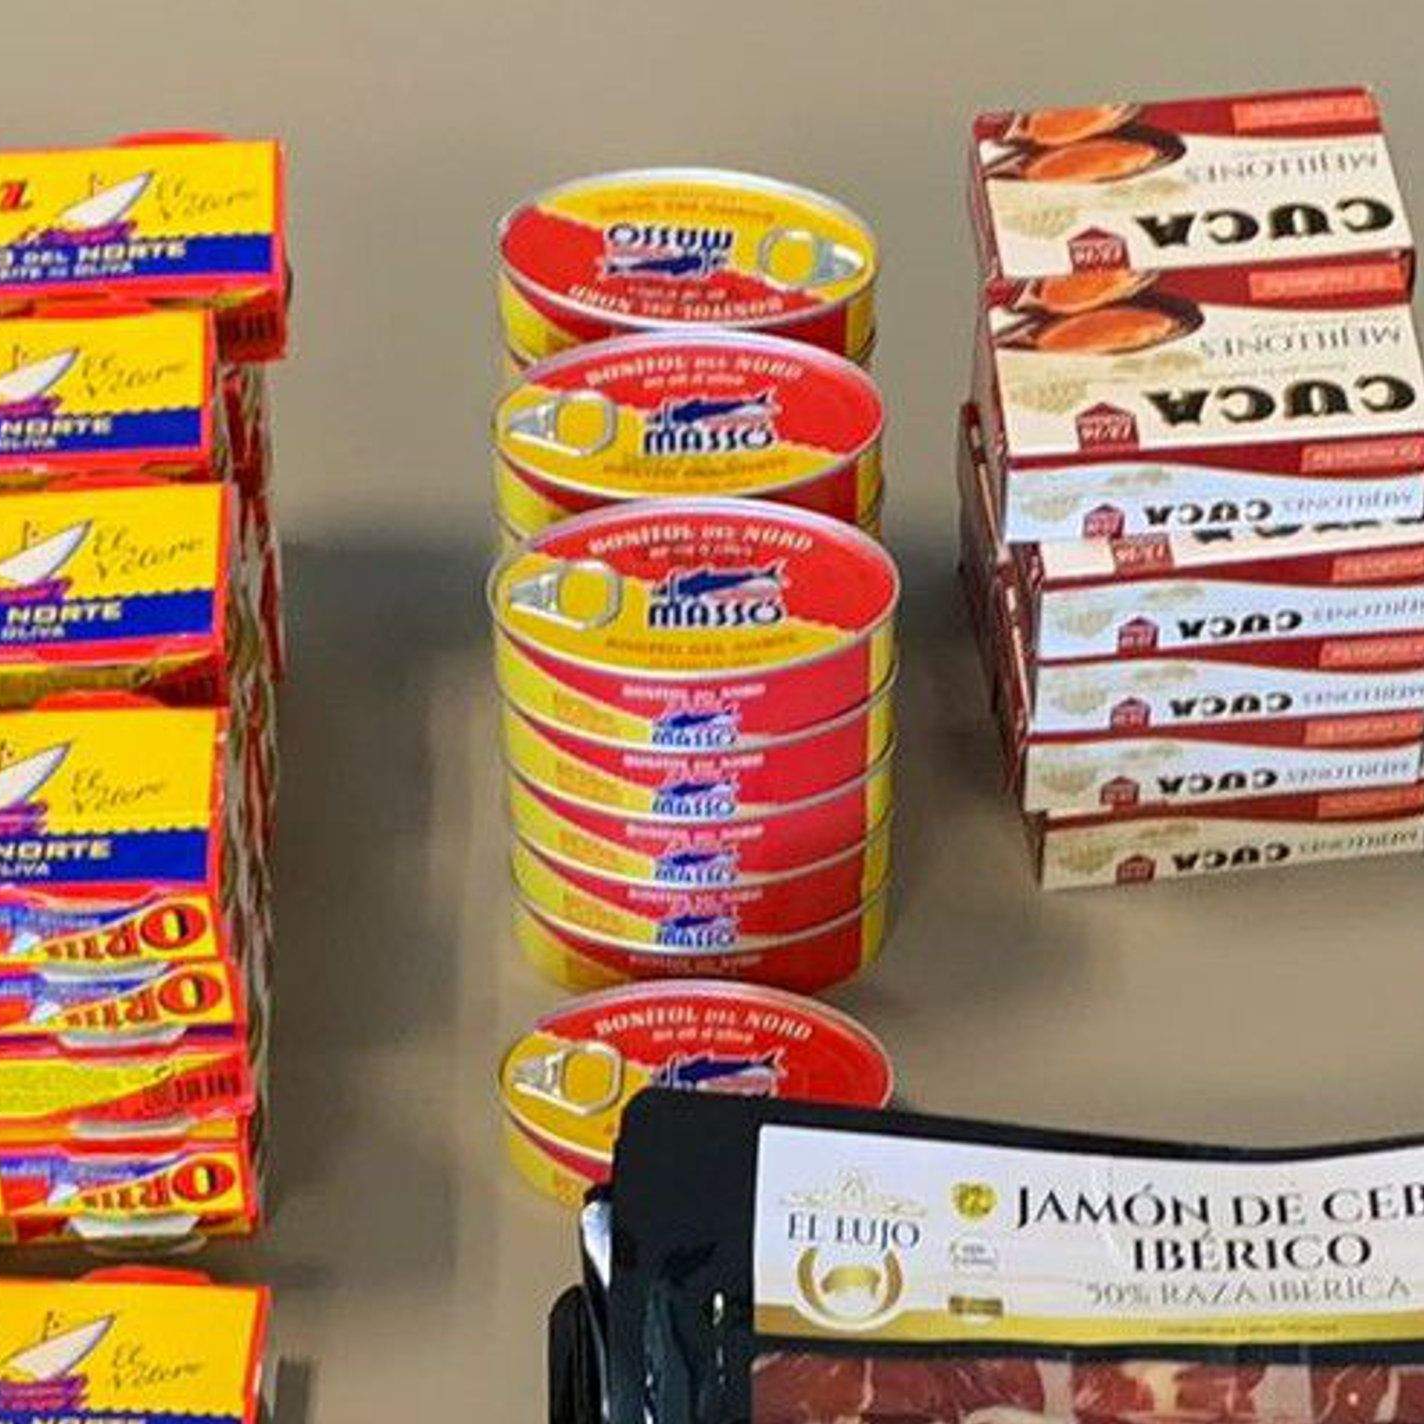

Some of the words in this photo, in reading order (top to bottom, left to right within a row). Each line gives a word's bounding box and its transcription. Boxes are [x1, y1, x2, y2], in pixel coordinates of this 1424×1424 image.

[1137, 198, 1394, 247] CUCA
[30, 250, 68, 264] DEL
[77, 241, 186, 262] NORTE
[75, 262, 134, 278] OLIVA
[1147, 375, 1416, 425] CUCA
[0, 417, 113, 437] NORTE
[1145, 500, 1273, 525] CUCA
[6, 603, 122, 624] NORTE
[1179, 611, 1303, 638] CUCA
[2, 623, 66, 640] OLIVA
[1170, 692, 1294, 716] CUCA
[1158, 768, 1277, 793] CUCA
[1172, 843, 1290, 869] CUCA
[1011, 1184, 1209, 1231] JAMÓN
[1231, 1195, 1303, 1227] DE
[788, 1213, 829, 1241] EL
[836, 1218, 921, 1251] LUJO
[1133, 1228, 1372, 1272] IBÉRICO
[1085, 1282, 1149, 1308] 50%
[1159, 1280, 1259, 1305] RAZA
[1267, 1275, 1412, 1303] IBÉRICA
